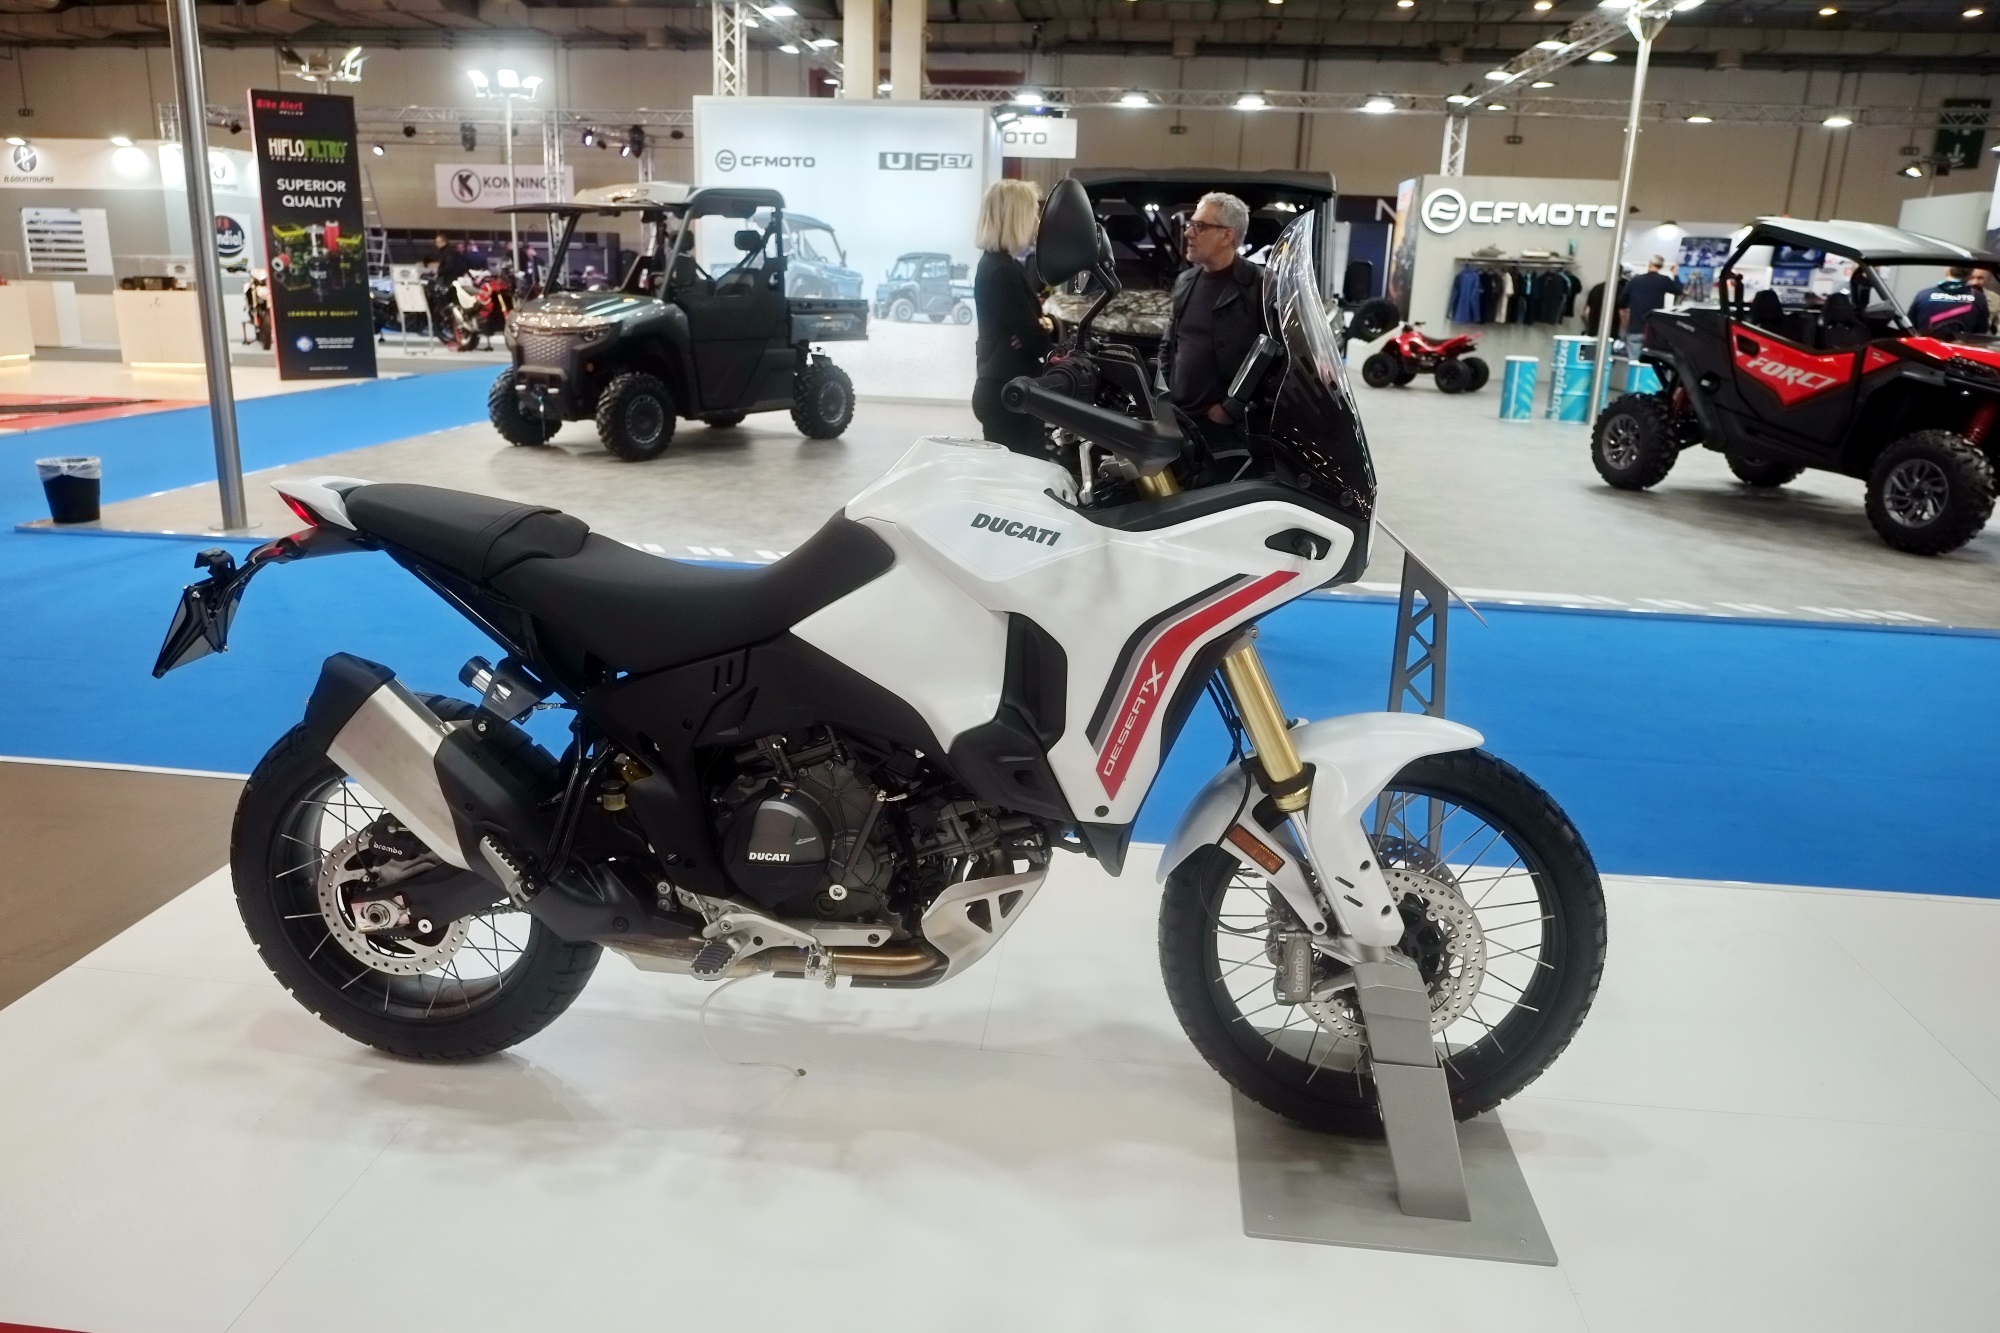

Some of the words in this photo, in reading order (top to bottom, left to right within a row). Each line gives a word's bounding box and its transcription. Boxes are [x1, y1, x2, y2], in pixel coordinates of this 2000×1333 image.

[1004, 131, 1047, 144] OTO
[268, 138, 346, 158] HIFLOFILTRO
[741, 155, 816, 168] CFMOTO
[276, 178, 346, 192] SUPERIOR
[281, 194, 343, 208] QUALITY
[217, 229, 244, 247] ndial
[970, 512, 1062, 547] DUCATI
[373, 841, 403, 855] brembo
[748, 852, 790, 863] DUCATI
[1293, 949, 1305, 993] brembo
